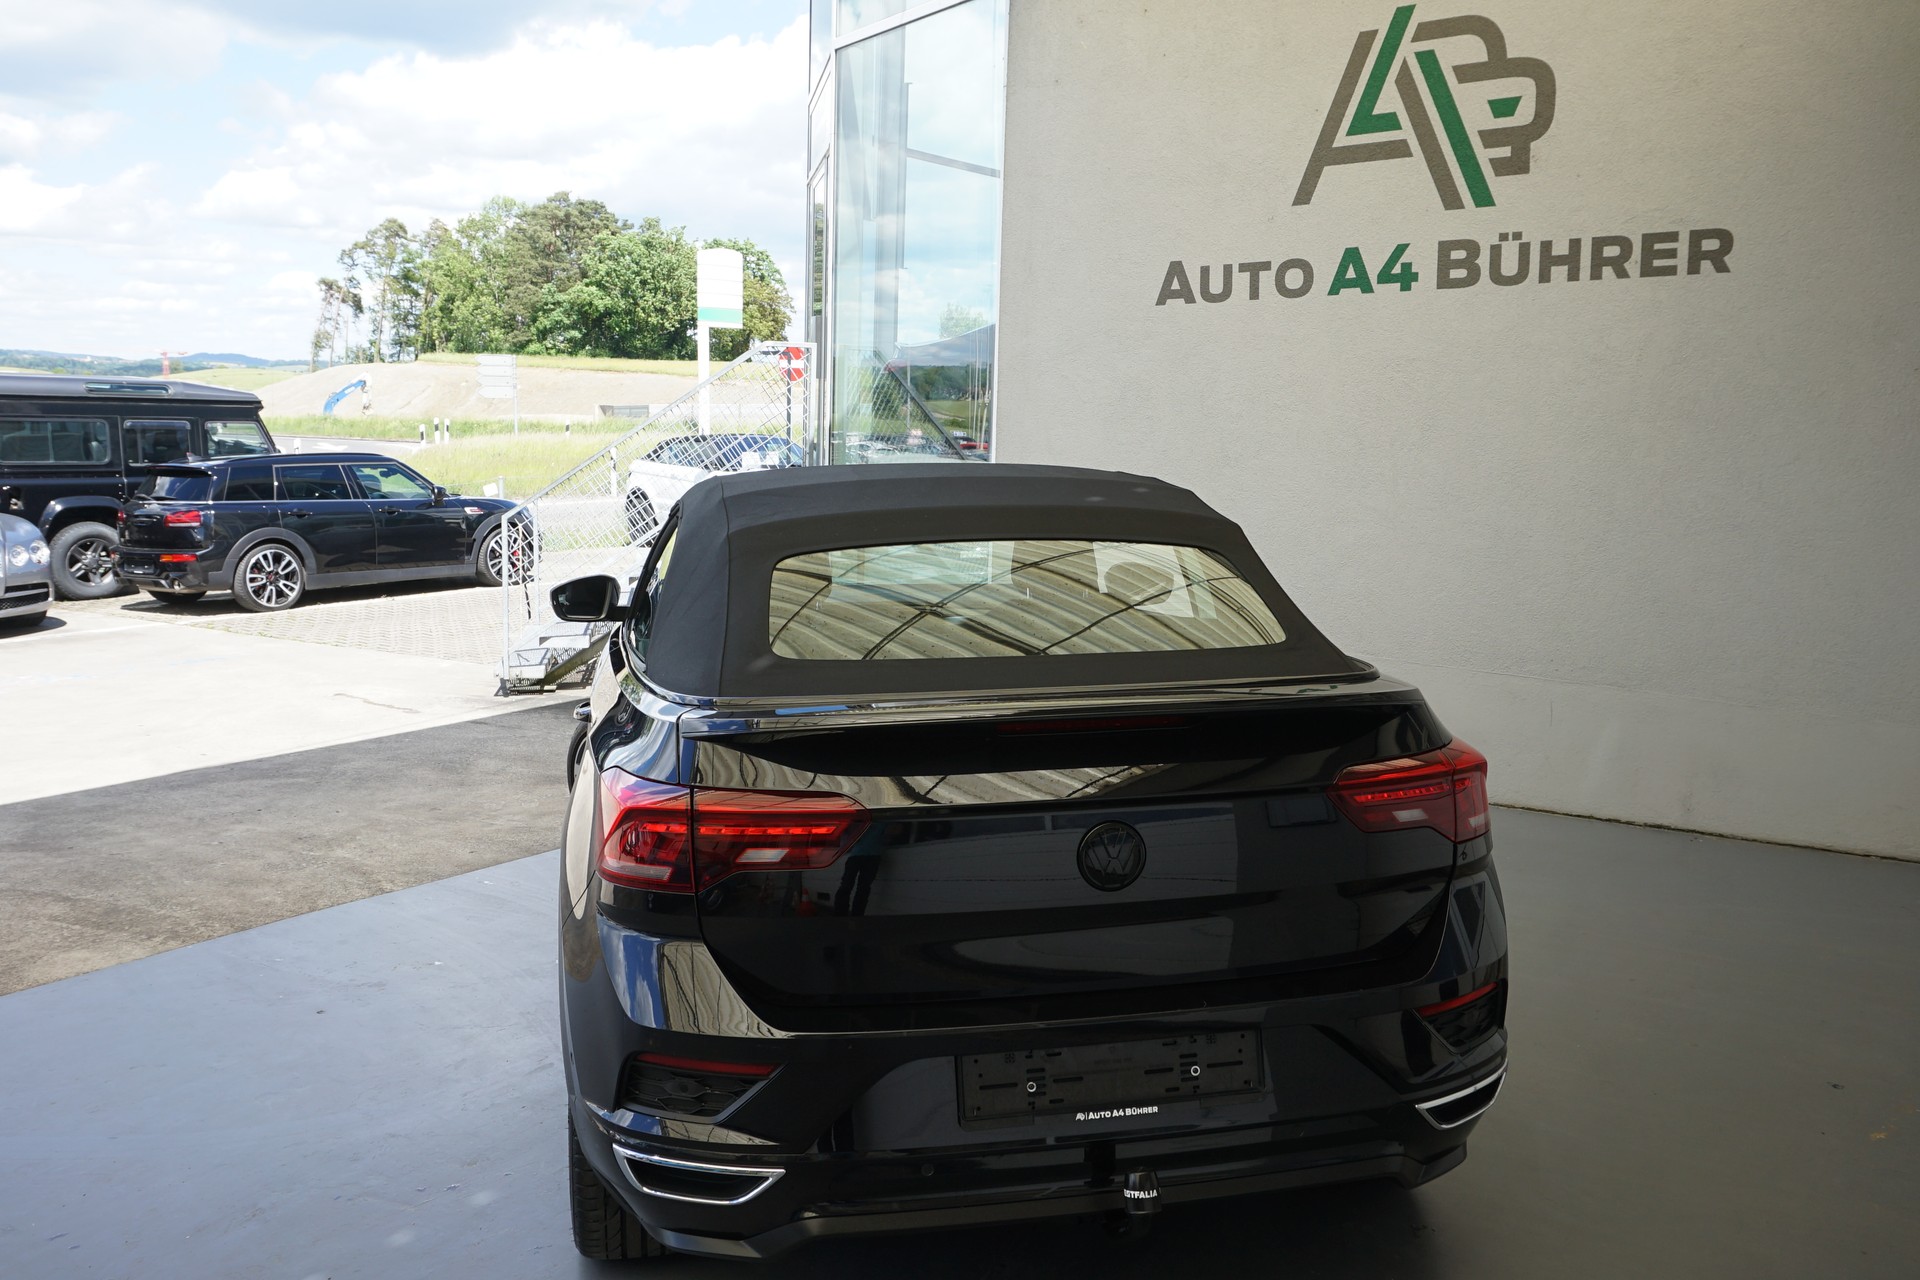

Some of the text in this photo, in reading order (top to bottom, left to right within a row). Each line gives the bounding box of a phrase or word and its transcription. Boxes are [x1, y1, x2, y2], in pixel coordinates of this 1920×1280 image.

[1155, 227, 1735, 307] AUTO A4 BÜHRER
[1088, 1111, 1111, 1120] AUTO
[1112, 1109, 1124, 1117] A4
